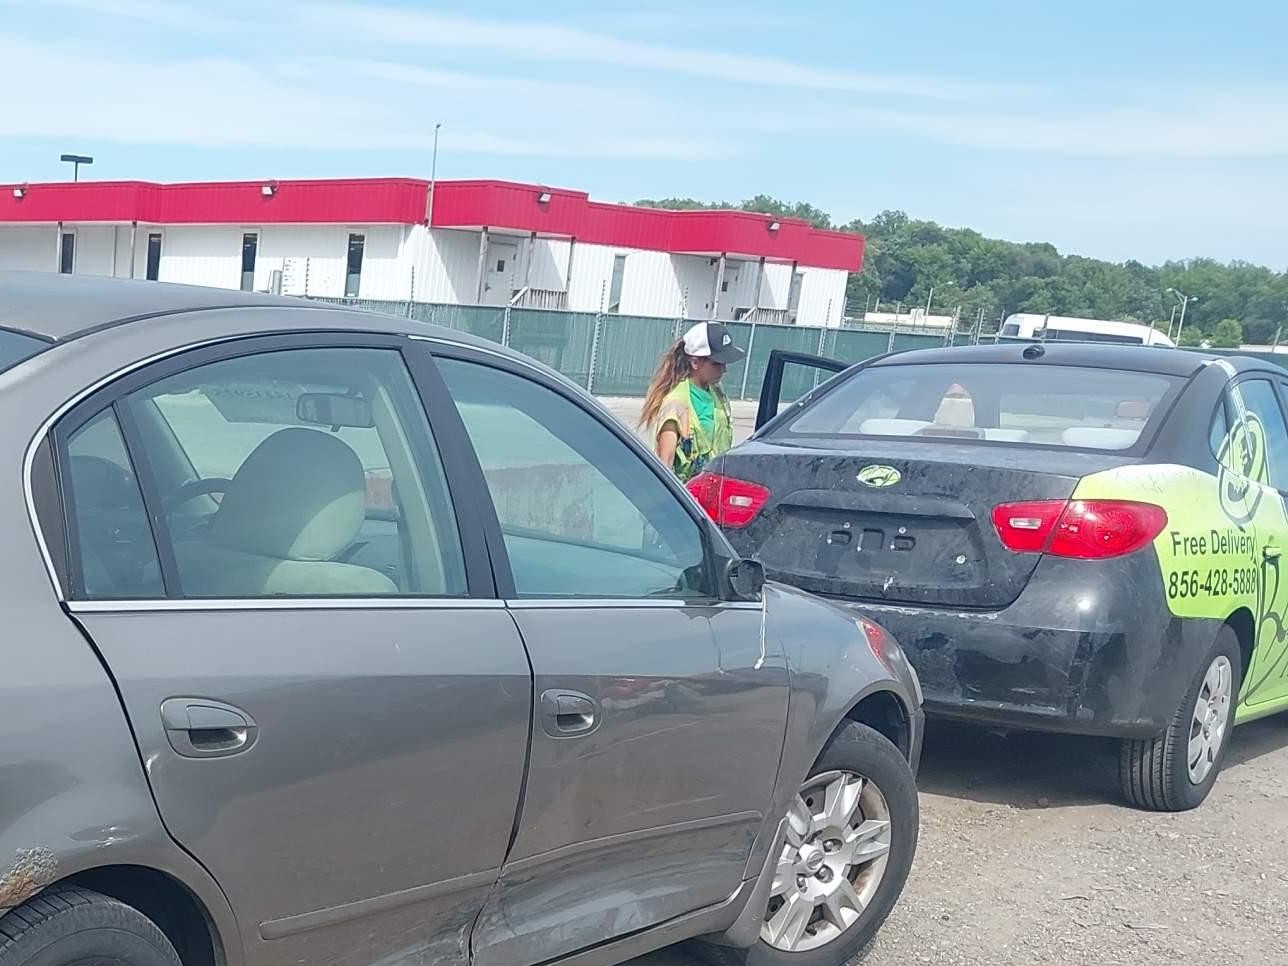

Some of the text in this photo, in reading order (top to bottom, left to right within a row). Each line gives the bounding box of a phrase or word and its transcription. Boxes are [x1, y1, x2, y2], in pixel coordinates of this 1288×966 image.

[1170, 529, 1257, 561] Free Delivery
[1168, 567, 1257, 599] 856-428-5888
